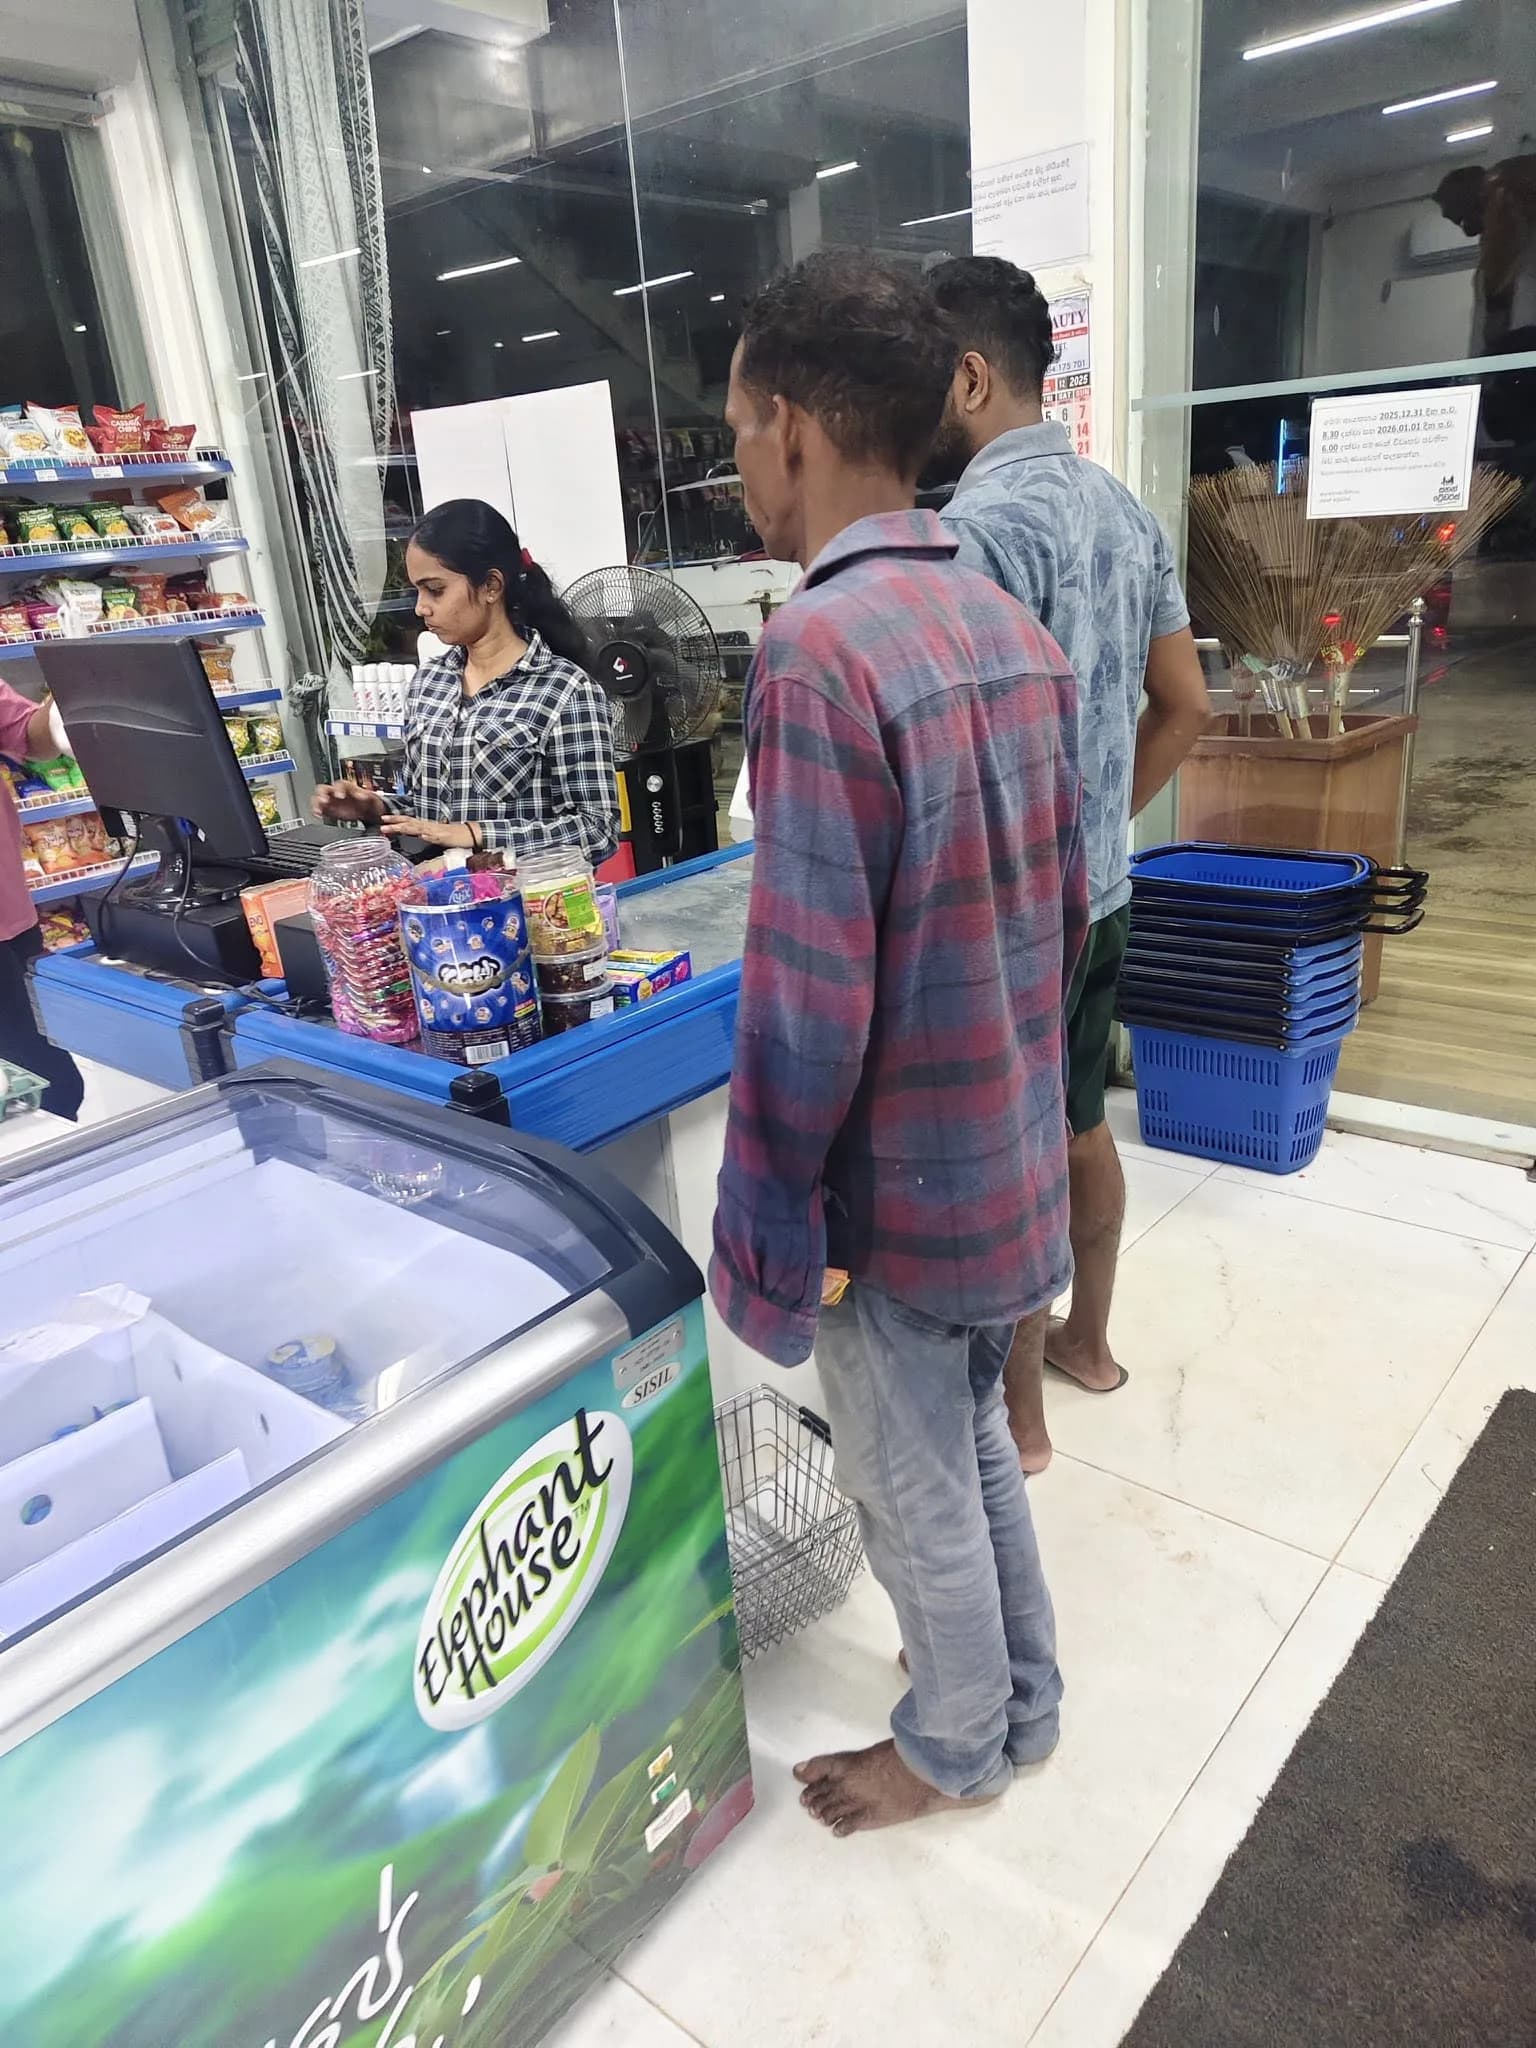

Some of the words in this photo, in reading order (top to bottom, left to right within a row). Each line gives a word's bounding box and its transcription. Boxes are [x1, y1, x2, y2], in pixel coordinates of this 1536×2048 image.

[1073, 359, 1086, 368] 701
[1069, 374, 1089, 388] 2025
[1057, 390, 1072, 401] SAT
[1062, 407, 1068, 421] 6
[1079, 405, 1086, 419] 7
[1379, 408, 1423, 421] 2025.12.31
[1077, 422, 1089, 438] 14
[1322, 429, 1339, 440] 8.30
[1377, 422, 1421, 434] 2026.01.01
[1077, 440, 1089, 454] 21
[1321, 444, 1338, 454] 6.00
[632, 1367, 672, 1404] SISIL
[418, 1407, 614, 1707] Elephant
[458, 1518, 582, 1700] House
